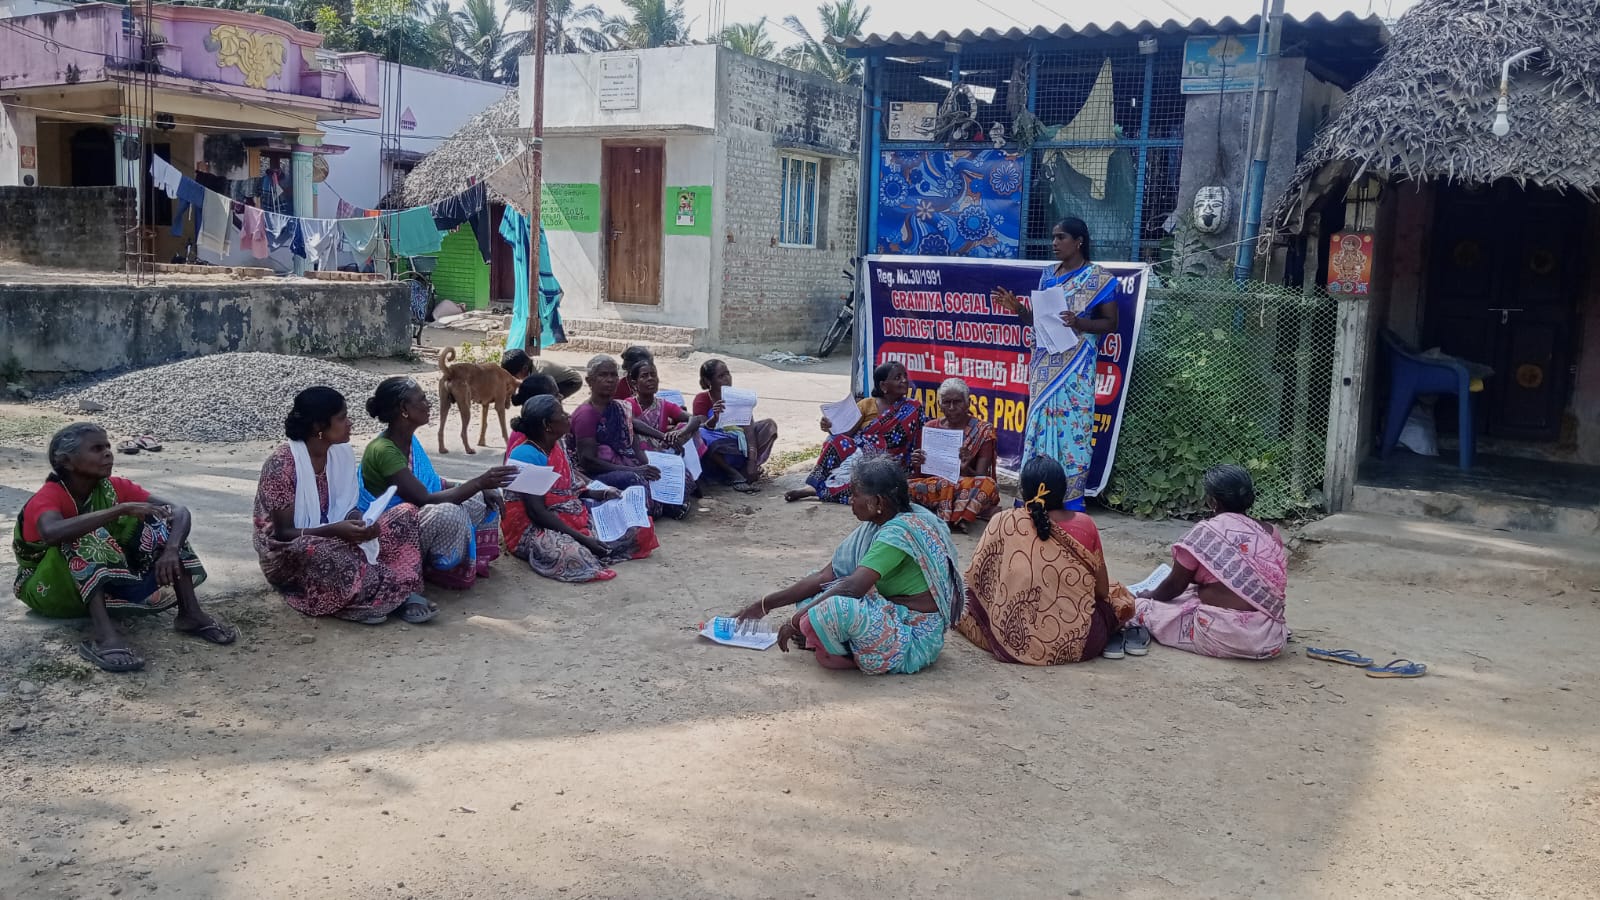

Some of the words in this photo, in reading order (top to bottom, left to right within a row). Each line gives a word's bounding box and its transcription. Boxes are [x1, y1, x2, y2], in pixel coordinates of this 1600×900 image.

[877, 268, 895, 287] Reg.
[896, 269, 942, 285] No.30/1991
[891, 290, 944, 313] GRAMIYA
[945, 292, 990, 316] SOCIAL
[883, 316, 935, 340] DISTRICT
[936, 319, 952, 341] DE
[954, 321, 1021, 346] ADDICTION
[944, 351, 1007, 387] போதை
